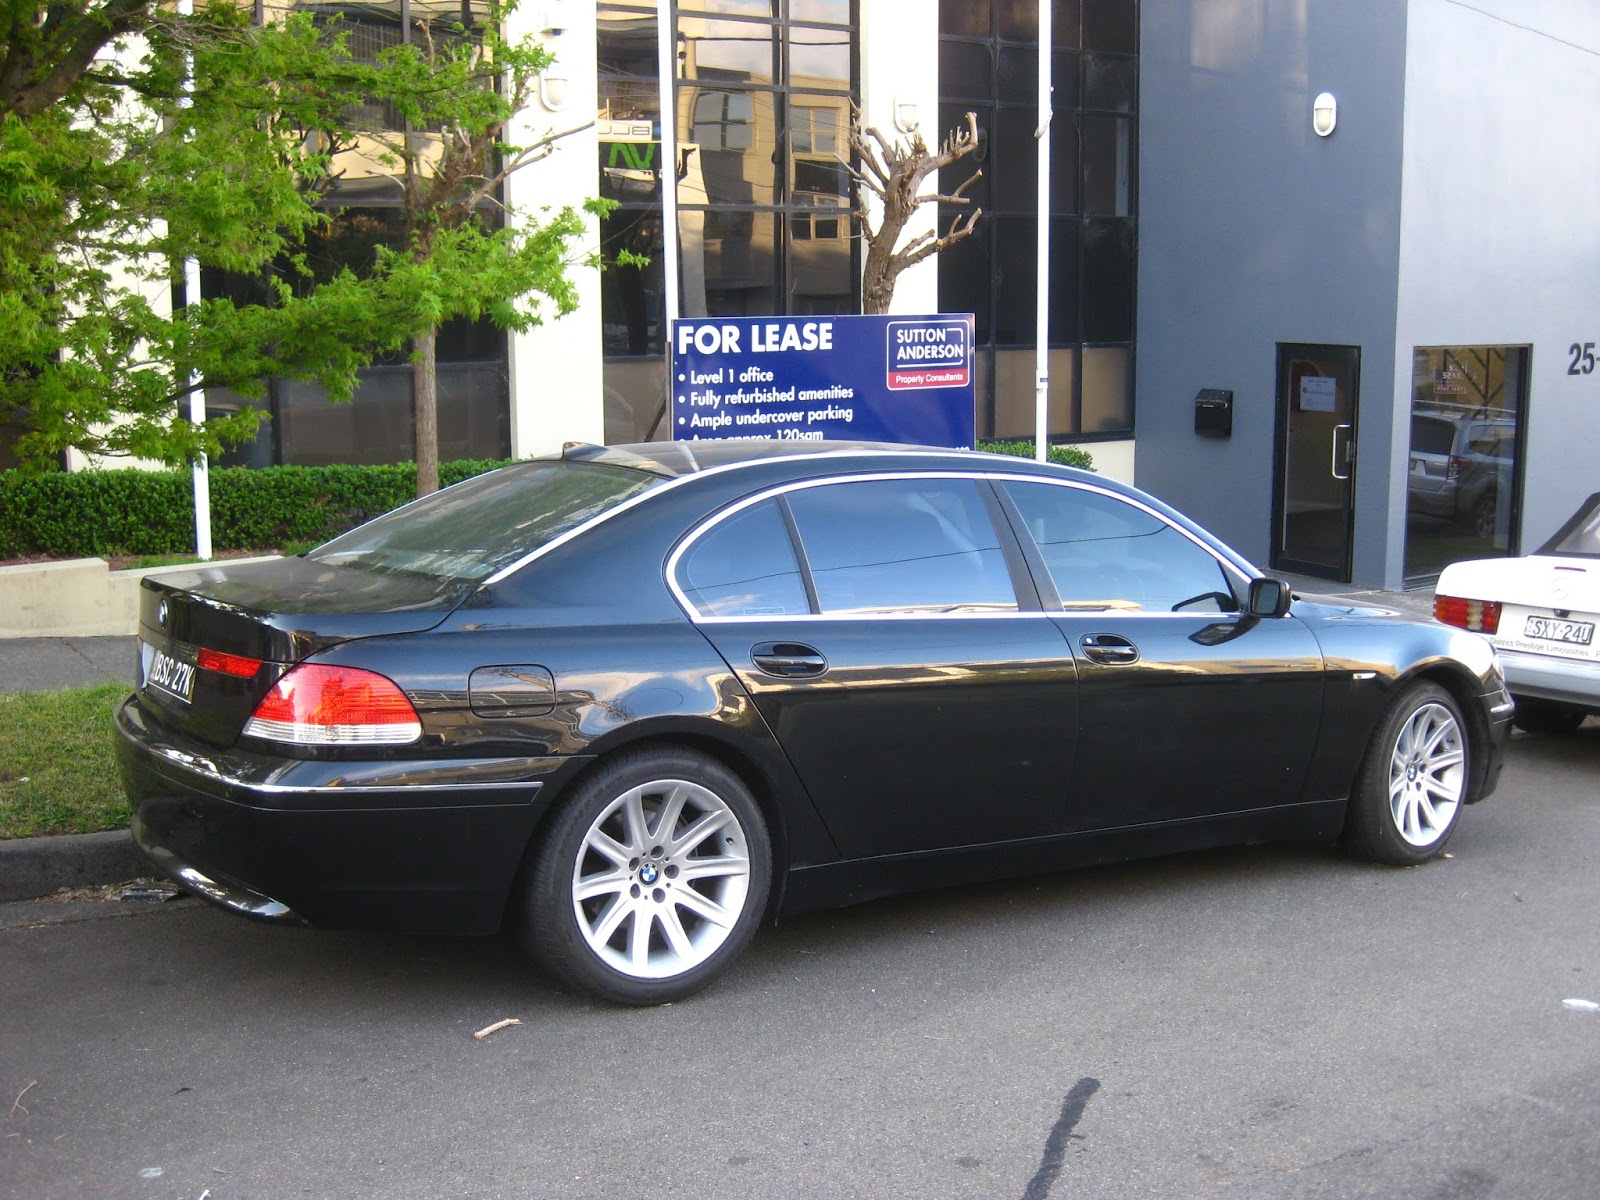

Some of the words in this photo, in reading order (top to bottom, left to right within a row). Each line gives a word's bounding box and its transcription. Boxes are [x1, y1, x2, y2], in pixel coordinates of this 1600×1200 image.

[679, 325, 741, 354] FOR
[752, 323, 833, 352] LEASE
[896, 328, 946, 343] SUTTON
[896, 344, 964, 360] ANDERSON
[690, 368, 723, 384] Level
[729, 369, 734, 383] 1
[739, 367, 774, 383] office
[895, 375, 924, 385] Property
[925, 373, 964, 382] Consultants
[690, 389, 721, 409] Fully
[725, 386, 795, 405] refurbished
[798, 385, 854, 400] amenities
[690, 411, 732, 430] Ample
[736, 409, 804, 425] undercover
[808, 405, 853, 425] parking
[1490, 637, 1513, 647] District
[1516, 640, 1544, 651] Prestige
[1546, 646, 1589, 657] Limousines
[154, 653, 175, 686] BSC
